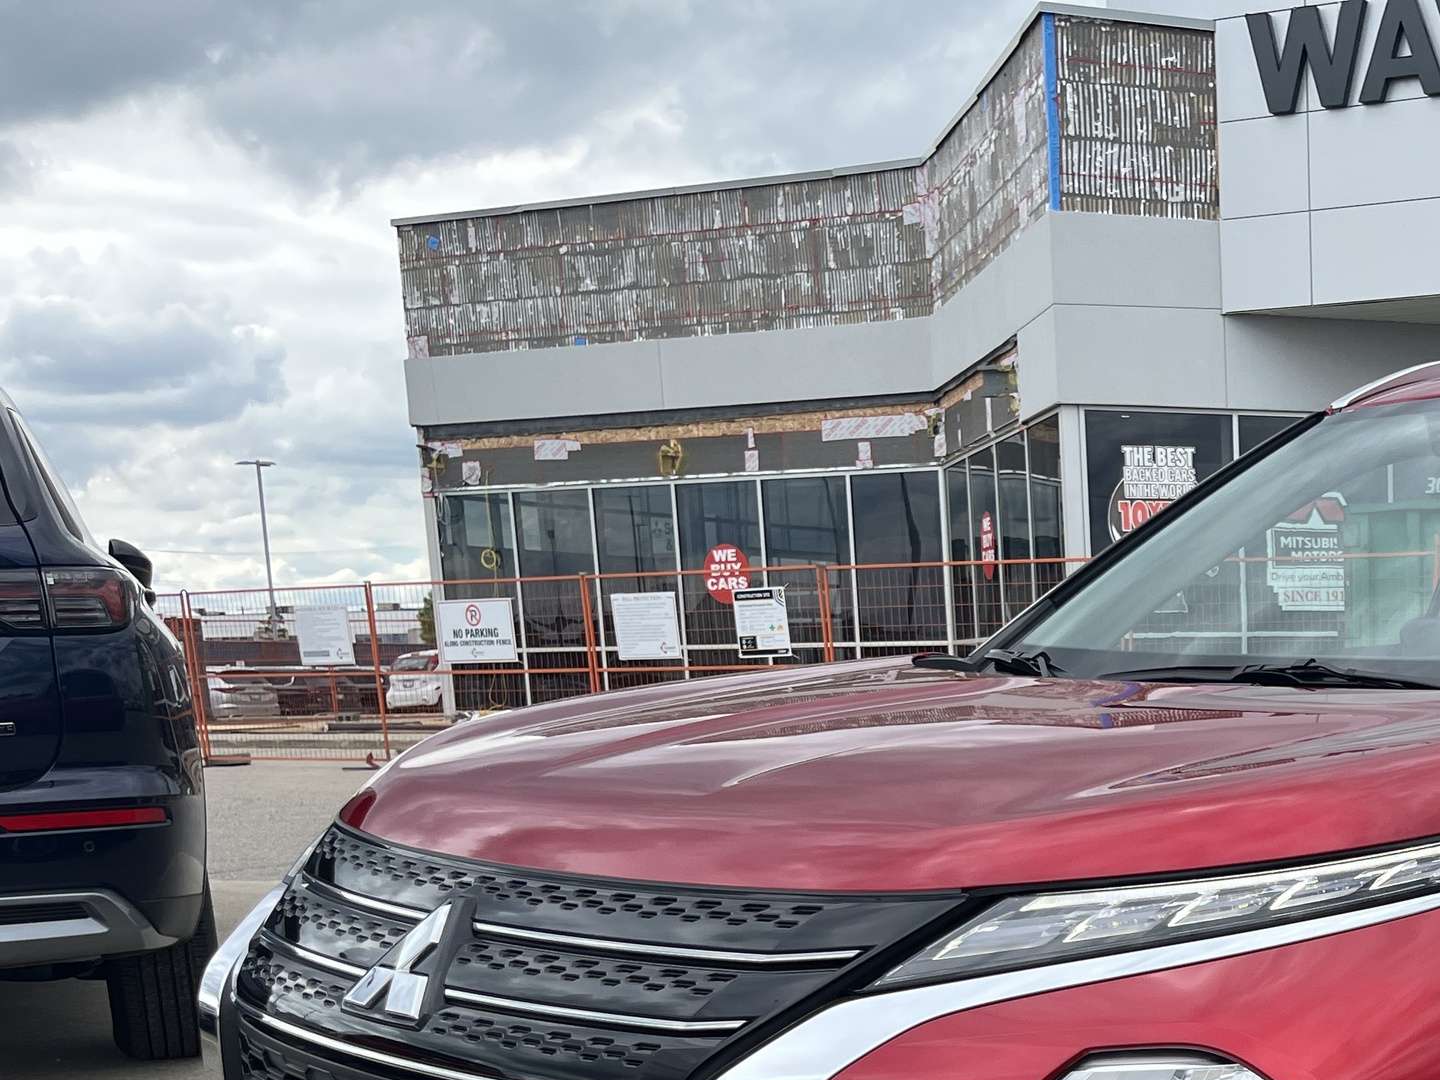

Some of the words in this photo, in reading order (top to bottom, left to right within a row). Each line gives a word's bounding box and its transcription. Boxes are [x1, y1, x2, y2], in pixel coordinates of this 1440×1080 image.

[1121, 445, 1153, 467] THE
[1155, 446, 1195, 468] BEST
[1124, 467, 1166, 482] BACKED
[1168, 467, 1196, 482] CARS
[1125, 483, 1137, 498] IN
[1137, 483, 1159, 498] THE
[712, 549, 737, 562] WE
[710, 562, 742, 576] BUY
[707, 577, 748, 590] CARS
[1283, 591, 1321, 602] SINCE
[453, 628, 463, 639] NO
[465, 627, 499, 638] PARKING
[460, 639, 495, 647] CONSTRUCTION
